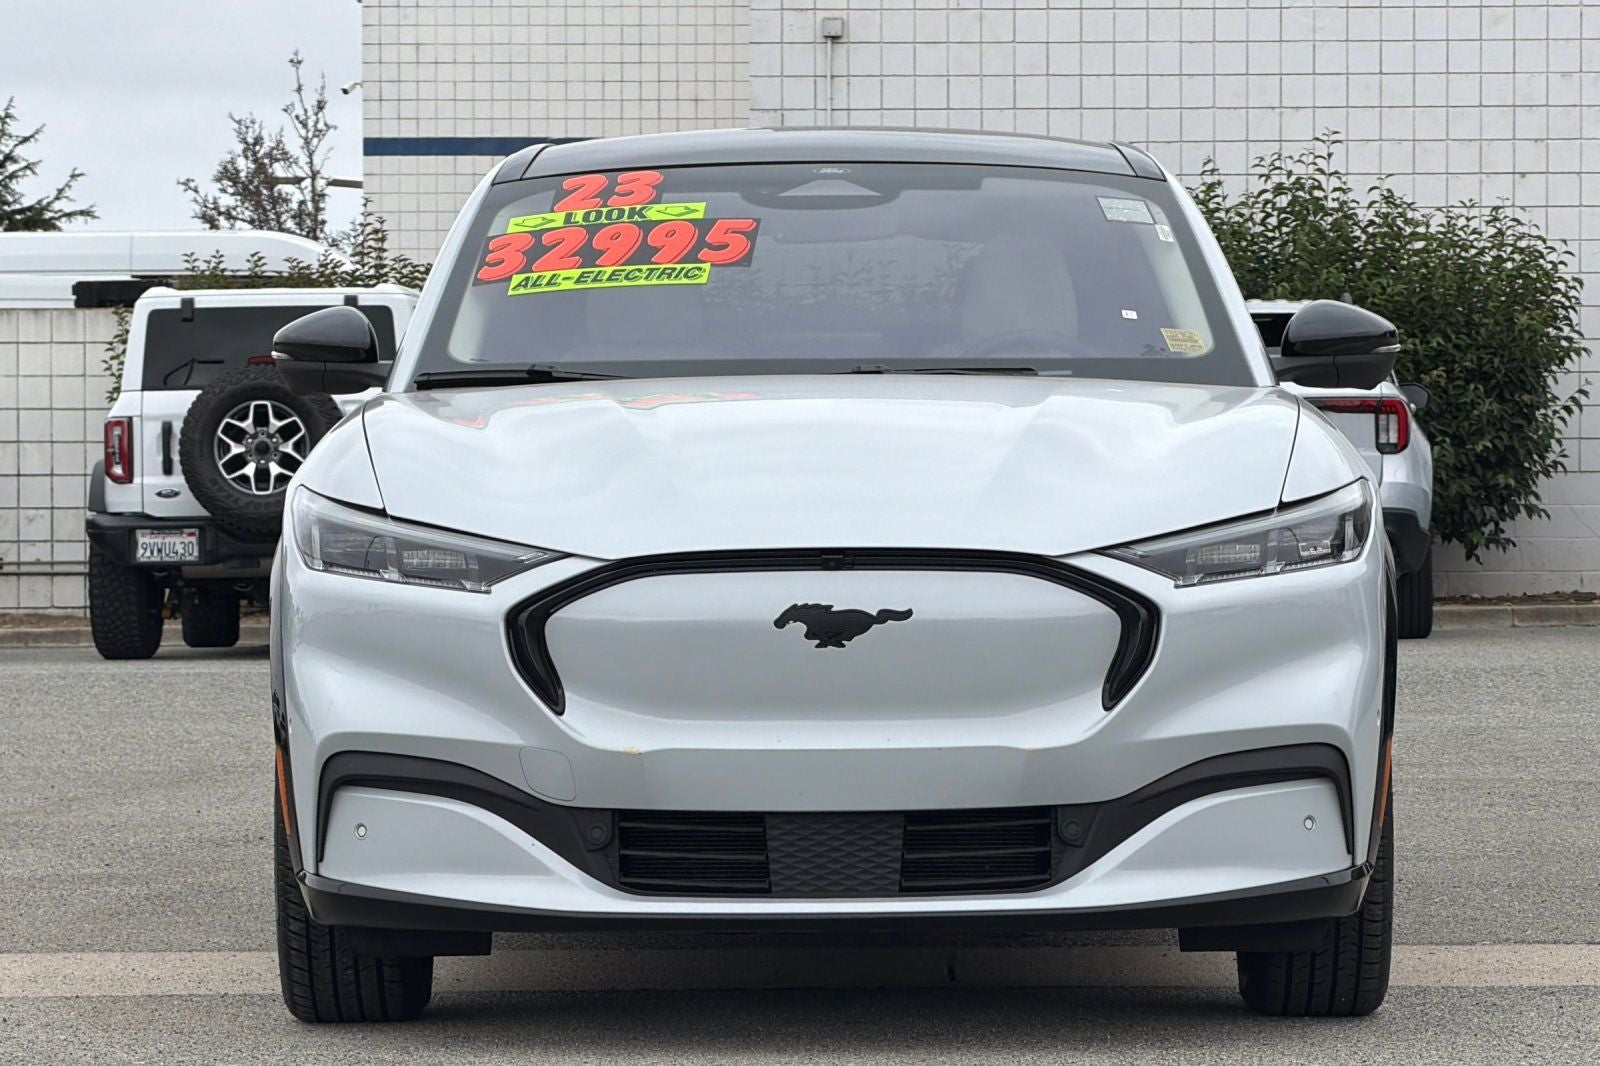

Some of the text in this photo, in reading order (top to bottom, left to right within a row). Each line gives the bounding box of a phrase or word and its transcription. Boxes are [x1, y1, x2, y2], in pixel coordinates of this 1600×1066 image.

[553, 170, 664, 212] 23
[562, 205, 654, 226] LOOK
[476, 218, 757, 282] 32995
[512, 266, 707, 291] ALL-ELECTRIC
[140, 541, 195, 558] 9VWU430
